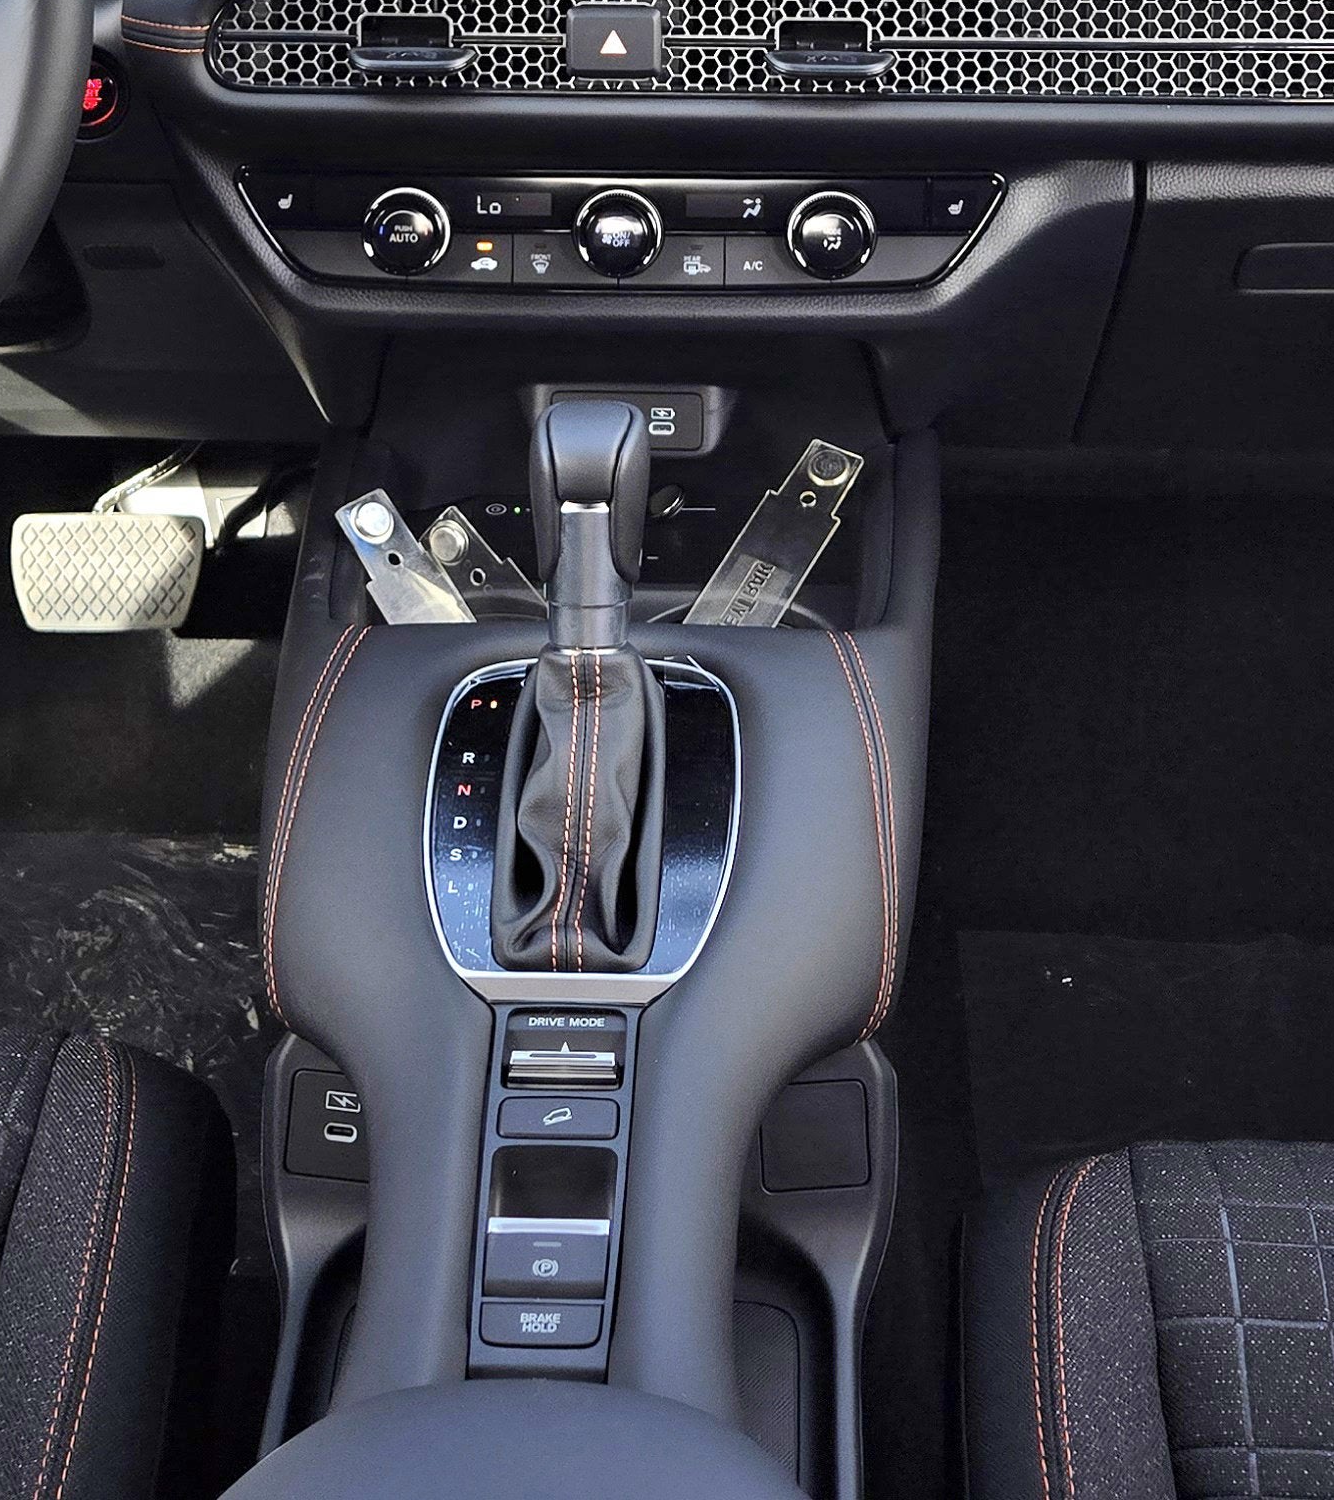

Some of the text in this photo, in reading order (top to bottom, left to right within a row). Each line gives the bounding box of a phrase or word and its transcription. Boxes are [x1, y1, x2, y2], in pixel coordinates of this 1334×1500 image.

[394, 225, 413, 233] PUSH
[389, 233, 418, 243] AUTO
[613, 232, 631, 240] ON/
[613, 238, 631, 247] OFF
[531, 253, 551, 261] FRONT
[743, 261, 763, 271] A/C
[470, 700, 483, 709] P
[462, 752, 476, 764] R
[457, 785, 471, 796] N
[453, 816, 467, 829] D
[449, 849, 463, 861] S
[447, 880, 458, 894] L
[528, 1017, 605, 1028] DRIVE MODE
[520, 1312, 561, 1324] BRAKE
[522, 1323, 557, 1333] HOLD
